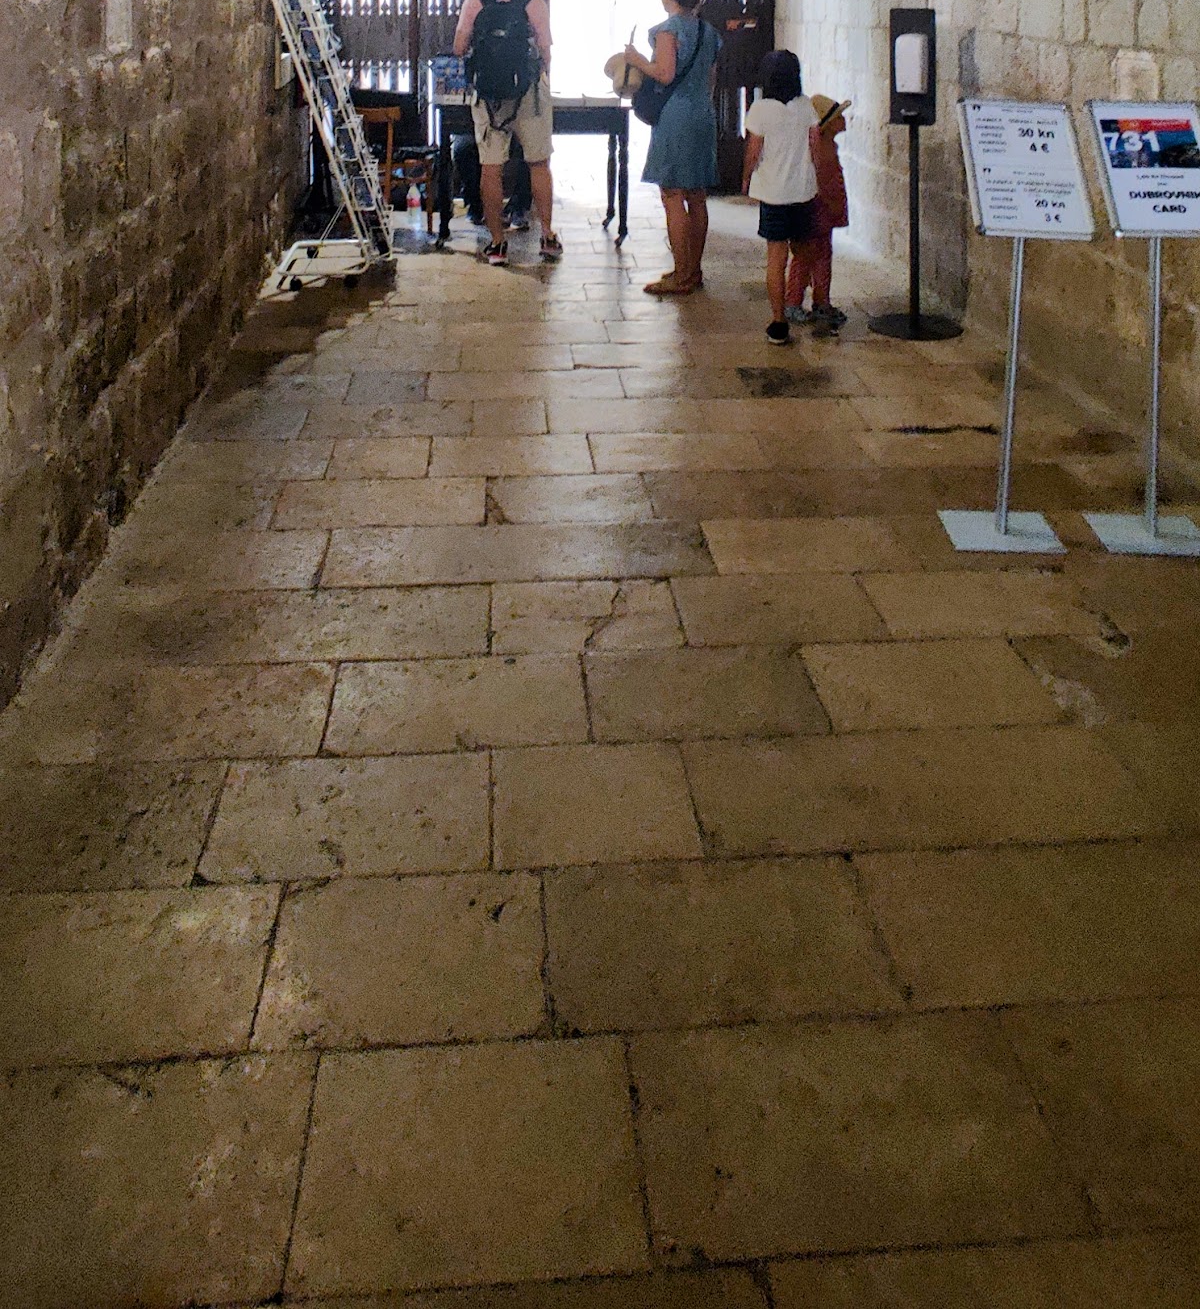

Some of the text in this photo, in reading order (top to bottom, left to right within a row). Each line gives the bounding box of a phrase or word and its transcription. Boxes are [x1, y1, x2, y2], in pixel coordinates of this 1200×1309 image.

[1018, 127, 1034, 138] 30
[1037, 128, 1055, 139] kn
[1029, 142, 1050, 153] 4 €
[1102, 131, 1161, 153] 731
[1034, 198, 1066, 209] 20 kn
[1153, 204, 1187, 214] CARD
[1044, 213, 1051, 223] 3
